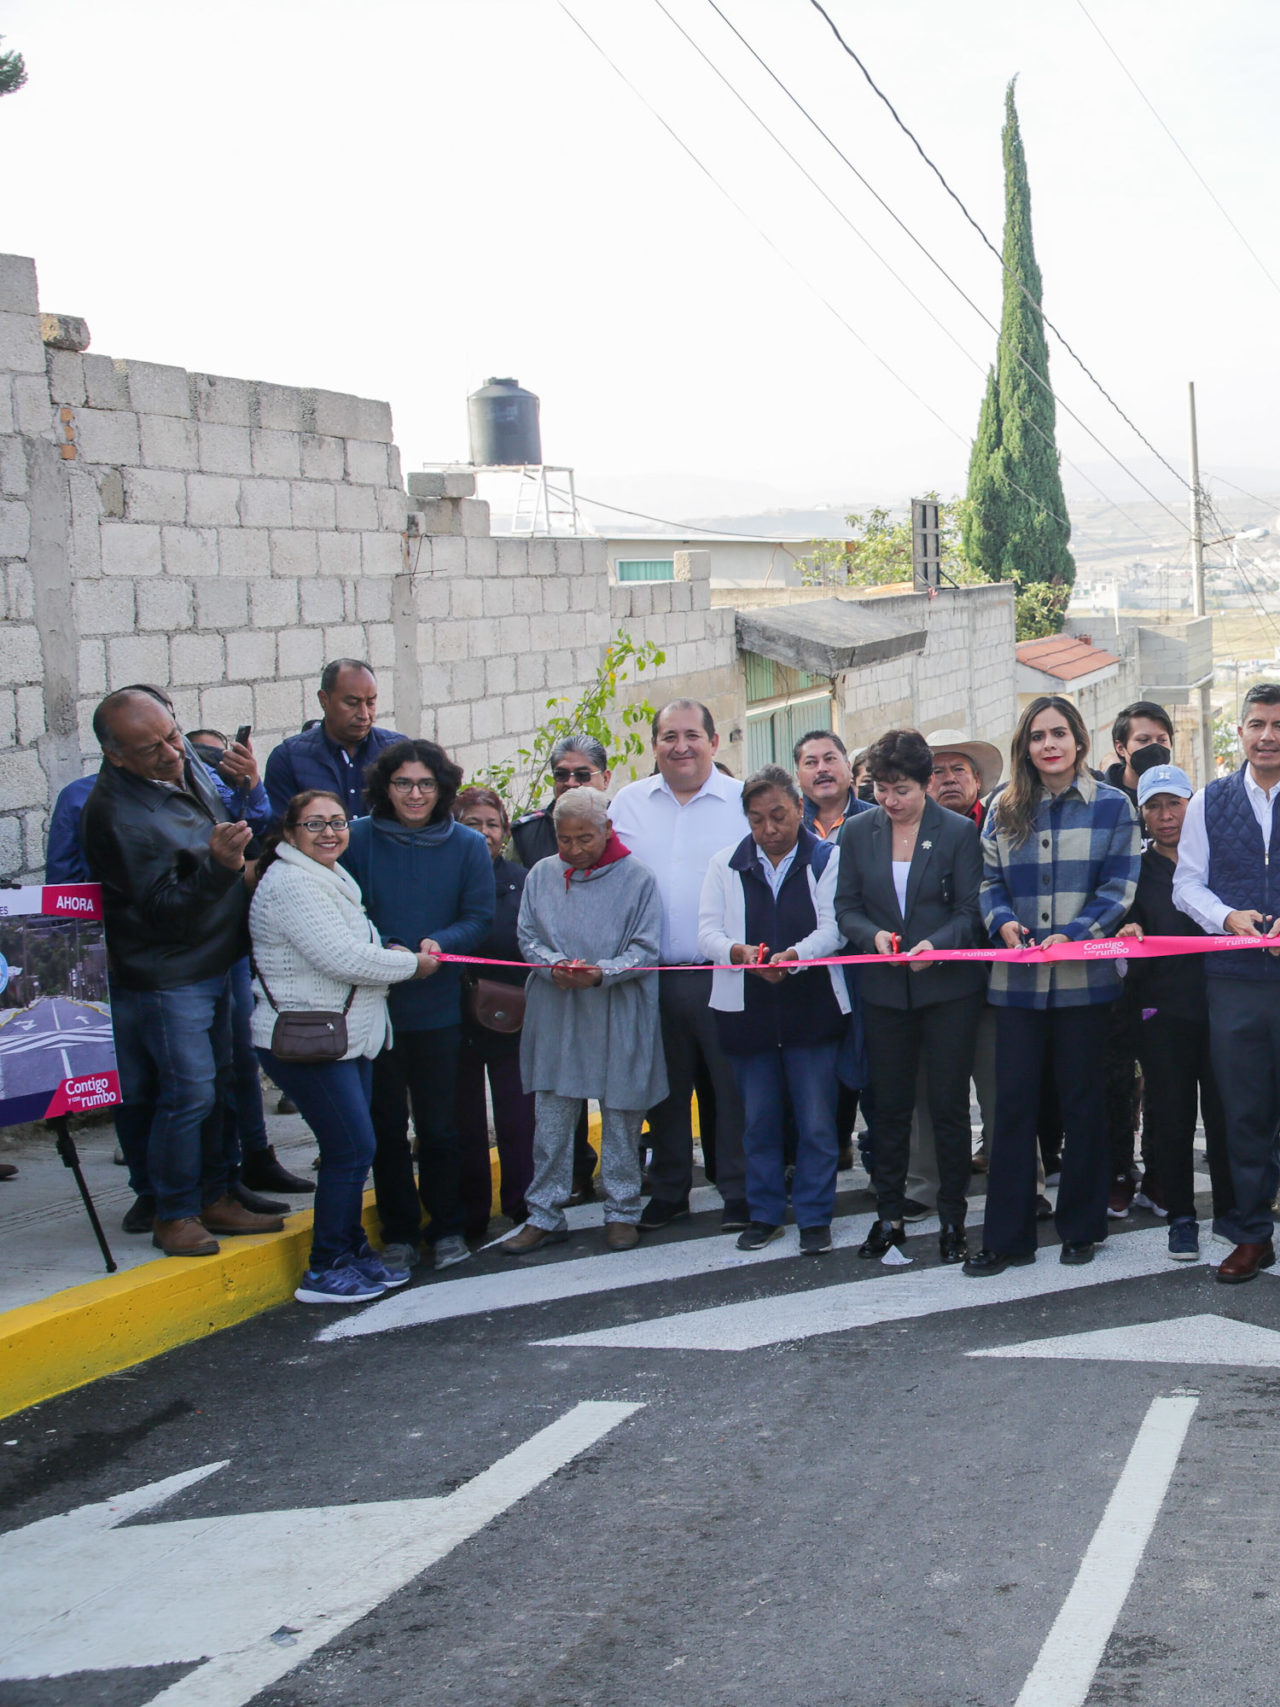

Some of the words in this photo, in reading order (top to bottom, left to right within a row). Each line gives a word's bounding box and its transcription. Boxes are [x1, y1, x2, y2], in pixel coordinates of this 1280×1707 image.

[56, 895, 94, 912] AHORA
[1083, 940, 1125, 951] Contigo
[1095, 946, 1130, 956] rumbo
[65, 1077, 109, 1095] Contigo
[81, 1090, 117, 1108] rumbo
